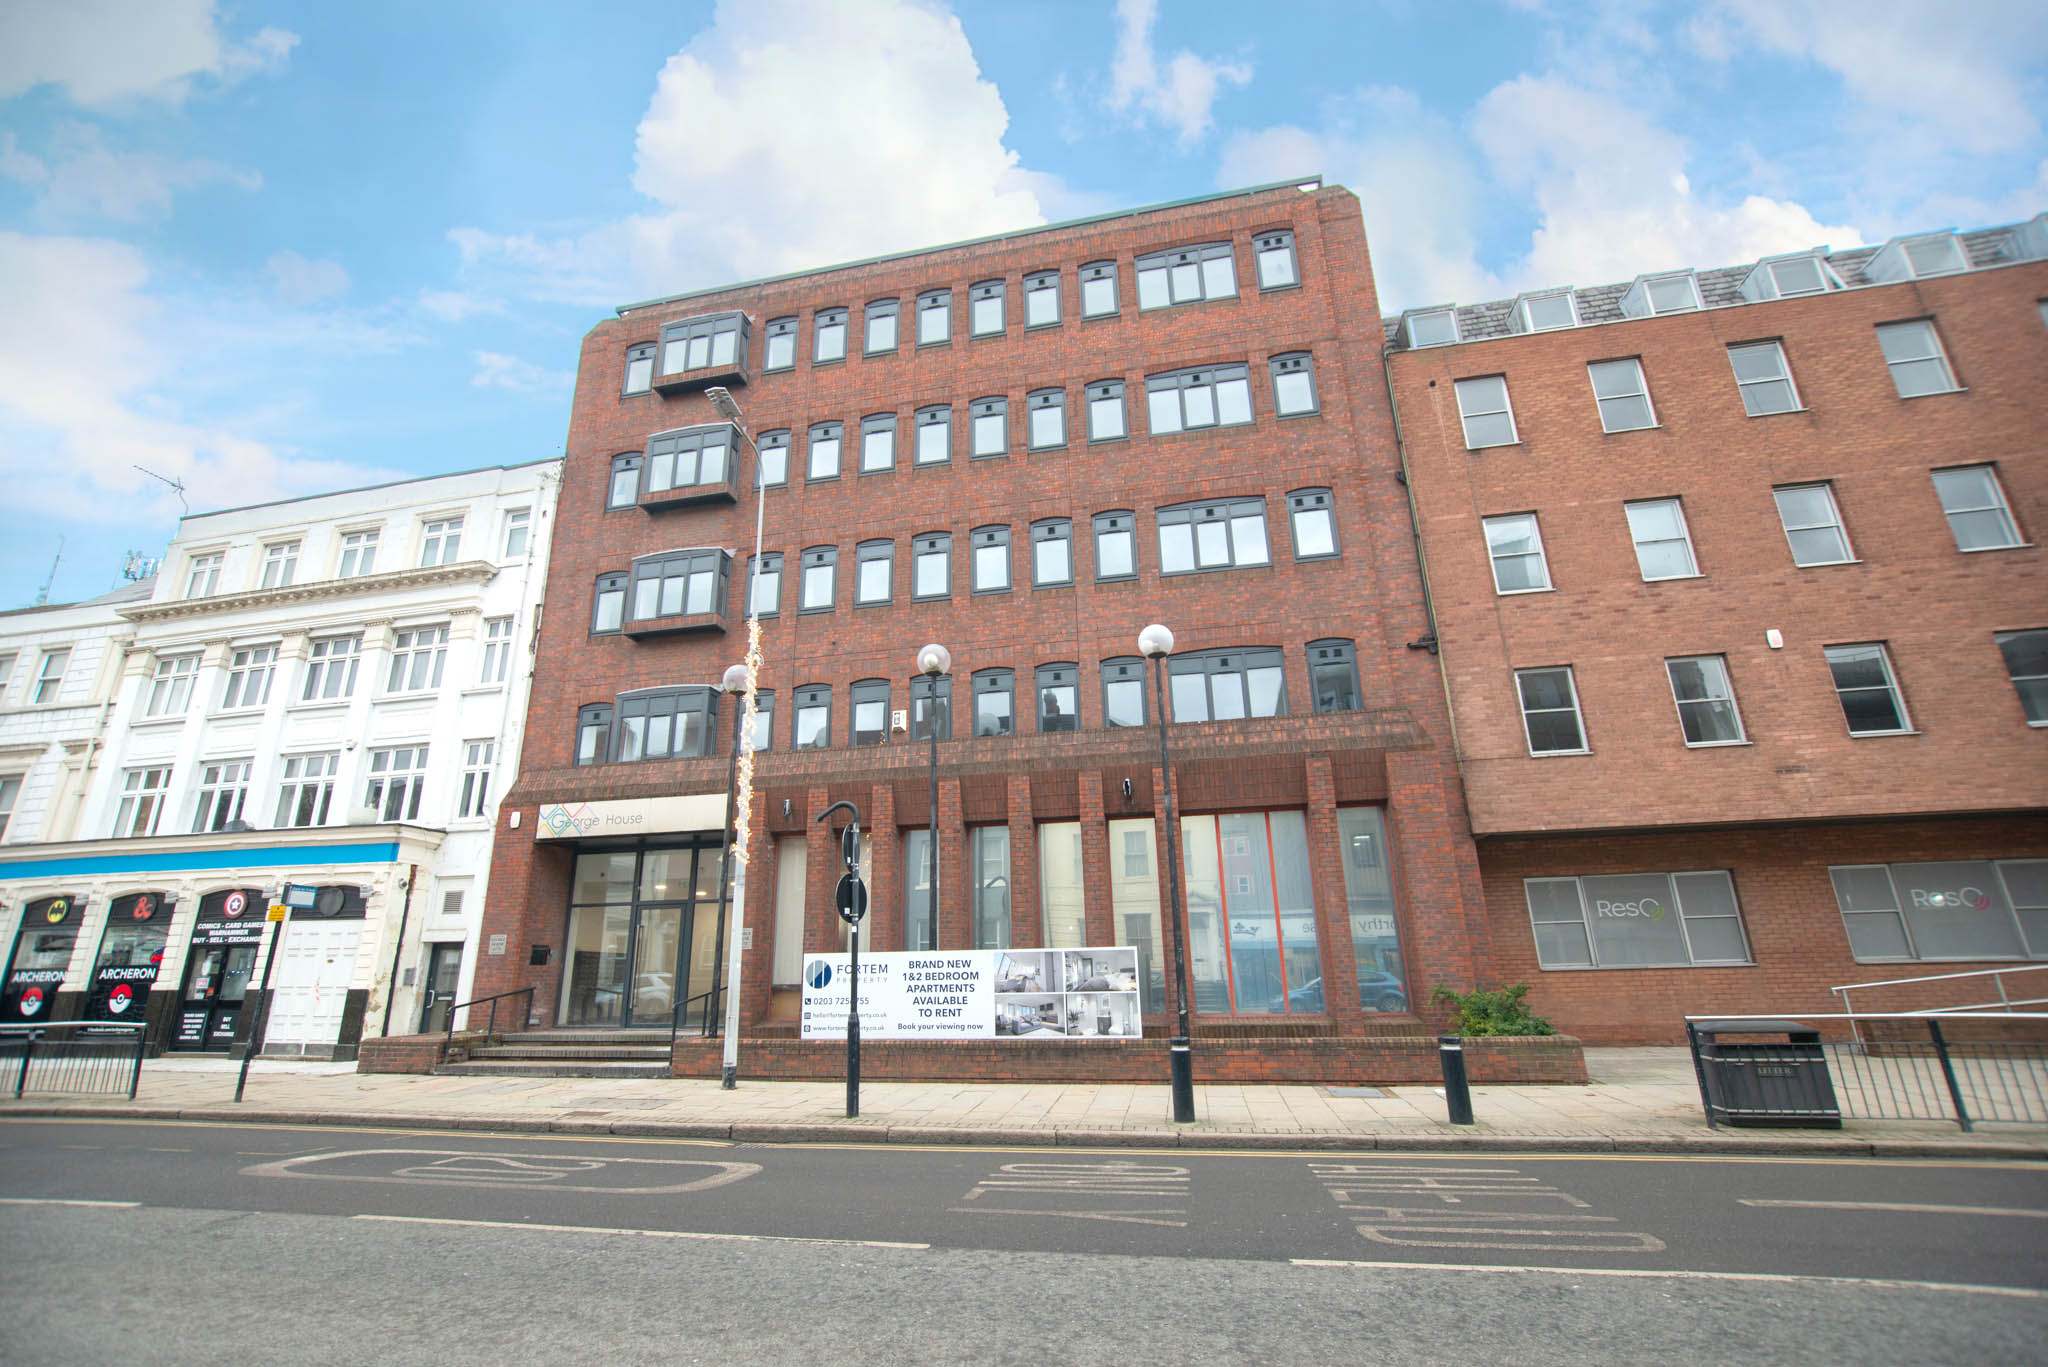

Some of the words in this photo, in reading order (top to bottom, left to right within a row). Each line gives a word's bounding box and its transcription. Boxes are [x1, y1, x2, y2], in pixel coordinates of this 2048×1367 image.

[551, 813, 600, 829] George
[606, 814, 643, 825] House
[908, 960, 945, 969] BRAND
[947, 959, 972, 968] NEW
[98, 968, 157, 979] ARCHERON
[902, 972, 922, 981] 1&2
[925, 971, 979, 981] BEDROOM
[906, 983, 975, 993] APARTMENTS
[835, 997, 870, 1005] 725755
[912, 996, 968, 1005] AVAILABLE
[918, 1008, 932, 1017] TO
[935, 1008, 962, 1017] RENT
[936, 1023, 965, 1031] viewing
